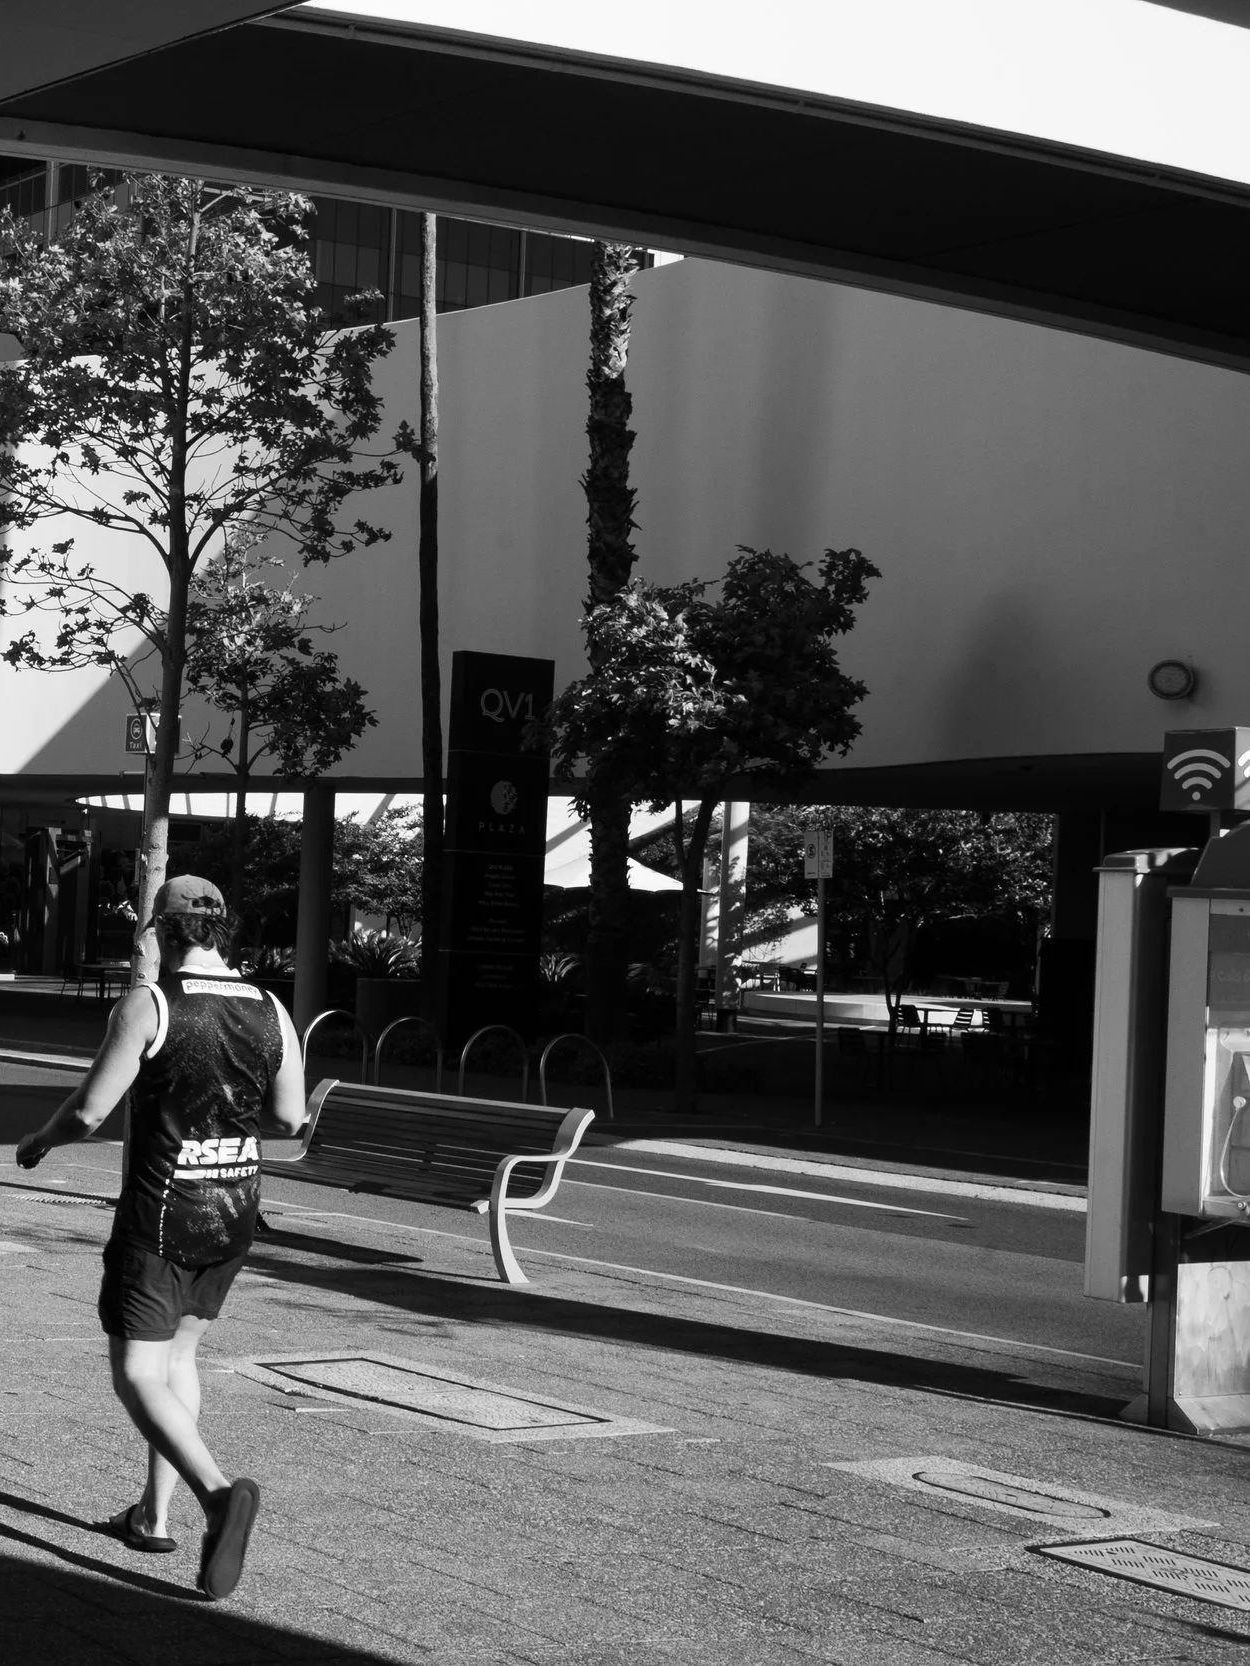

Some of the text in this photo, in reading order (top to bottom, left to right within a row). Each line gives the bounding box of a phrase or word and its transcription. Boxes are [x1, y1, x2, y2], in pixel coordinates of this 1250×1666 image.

[480, 688, 535, 723] QV1
[478, 821, 526, 836] PLAZA
[177, 1136, 259, 1165] RSEA
[220, 1165, 259, 1178] SAFETY
